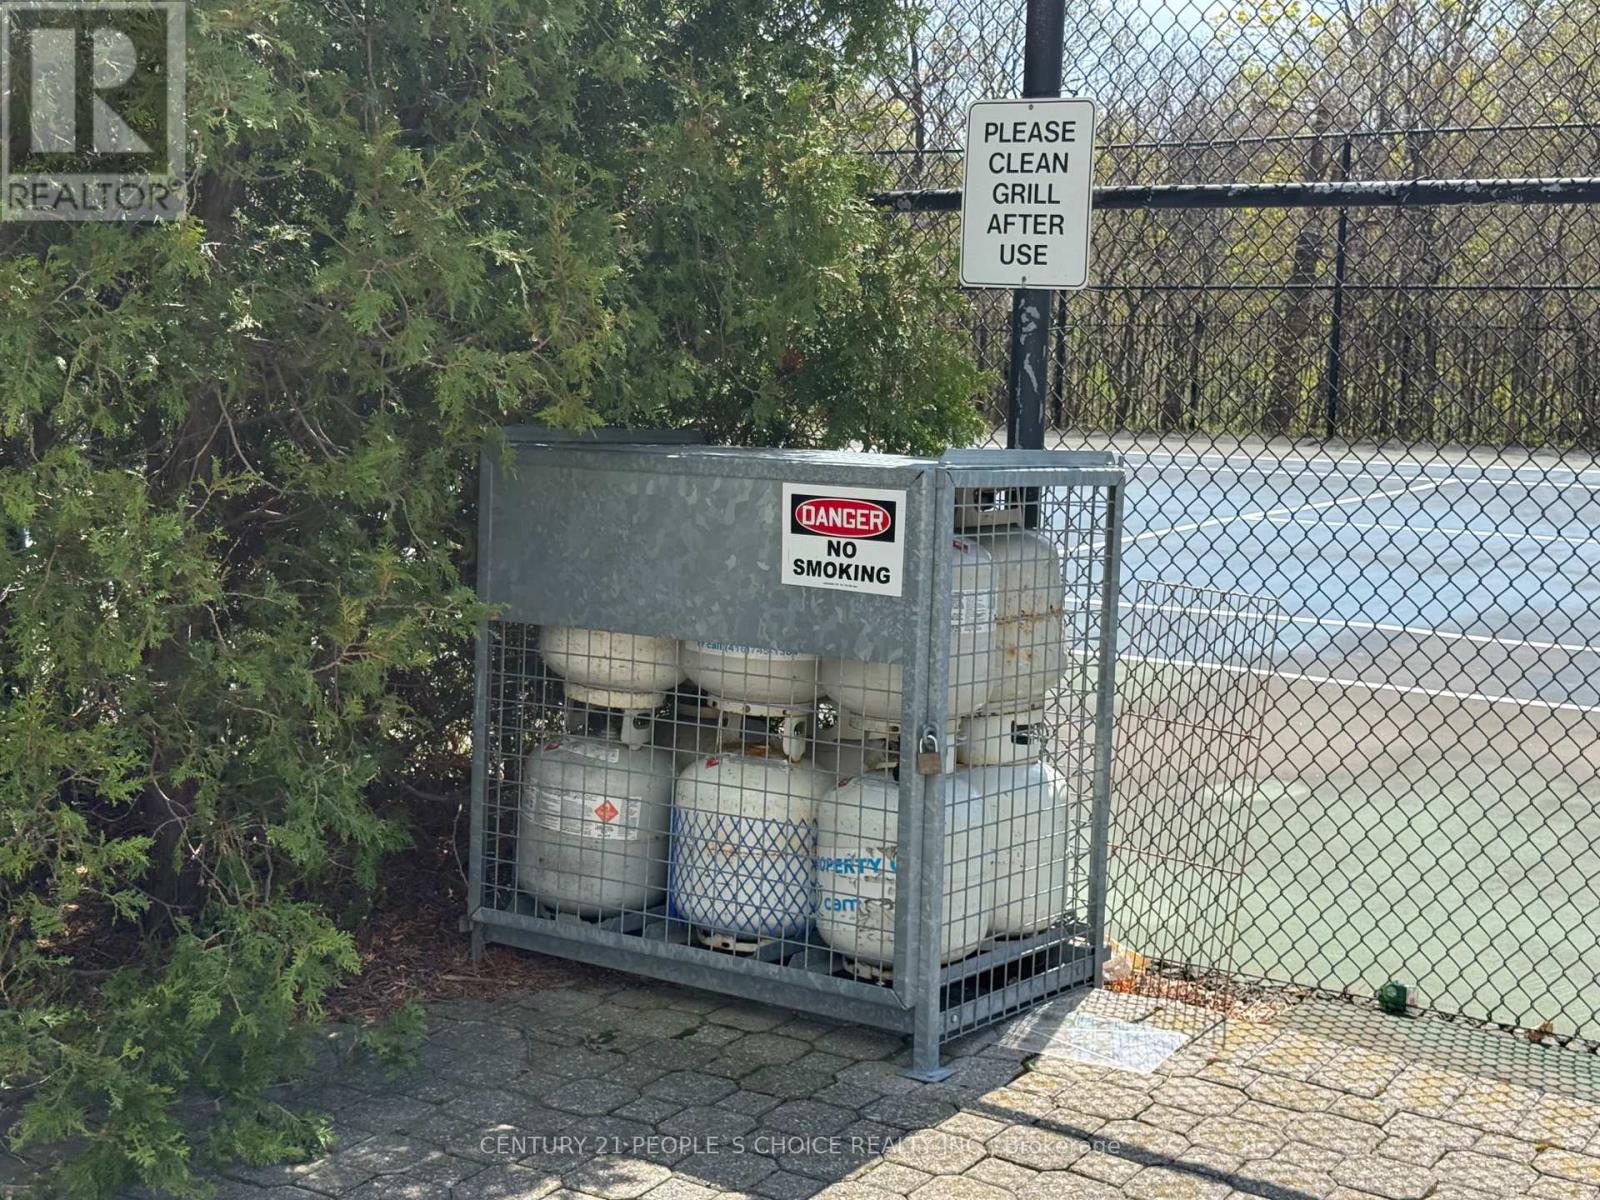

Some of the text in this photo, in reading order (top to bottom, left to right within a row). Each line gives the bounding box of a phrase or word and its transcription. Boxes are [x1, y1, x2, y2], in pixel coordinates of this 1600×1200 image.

[984, 121, 1076, 143] PLEASE
[988, 152, 1069, 174] CLEAN
[992, 182, 1061, 204] GRILL
[986, 213, 1065, 235] AFTER
[999, 244, 1048, 266] USE
[801, 505, 884, 531] DANGER
[826, 540, 857, 559] NO
[792, 558, 891, 585] SMOKING
